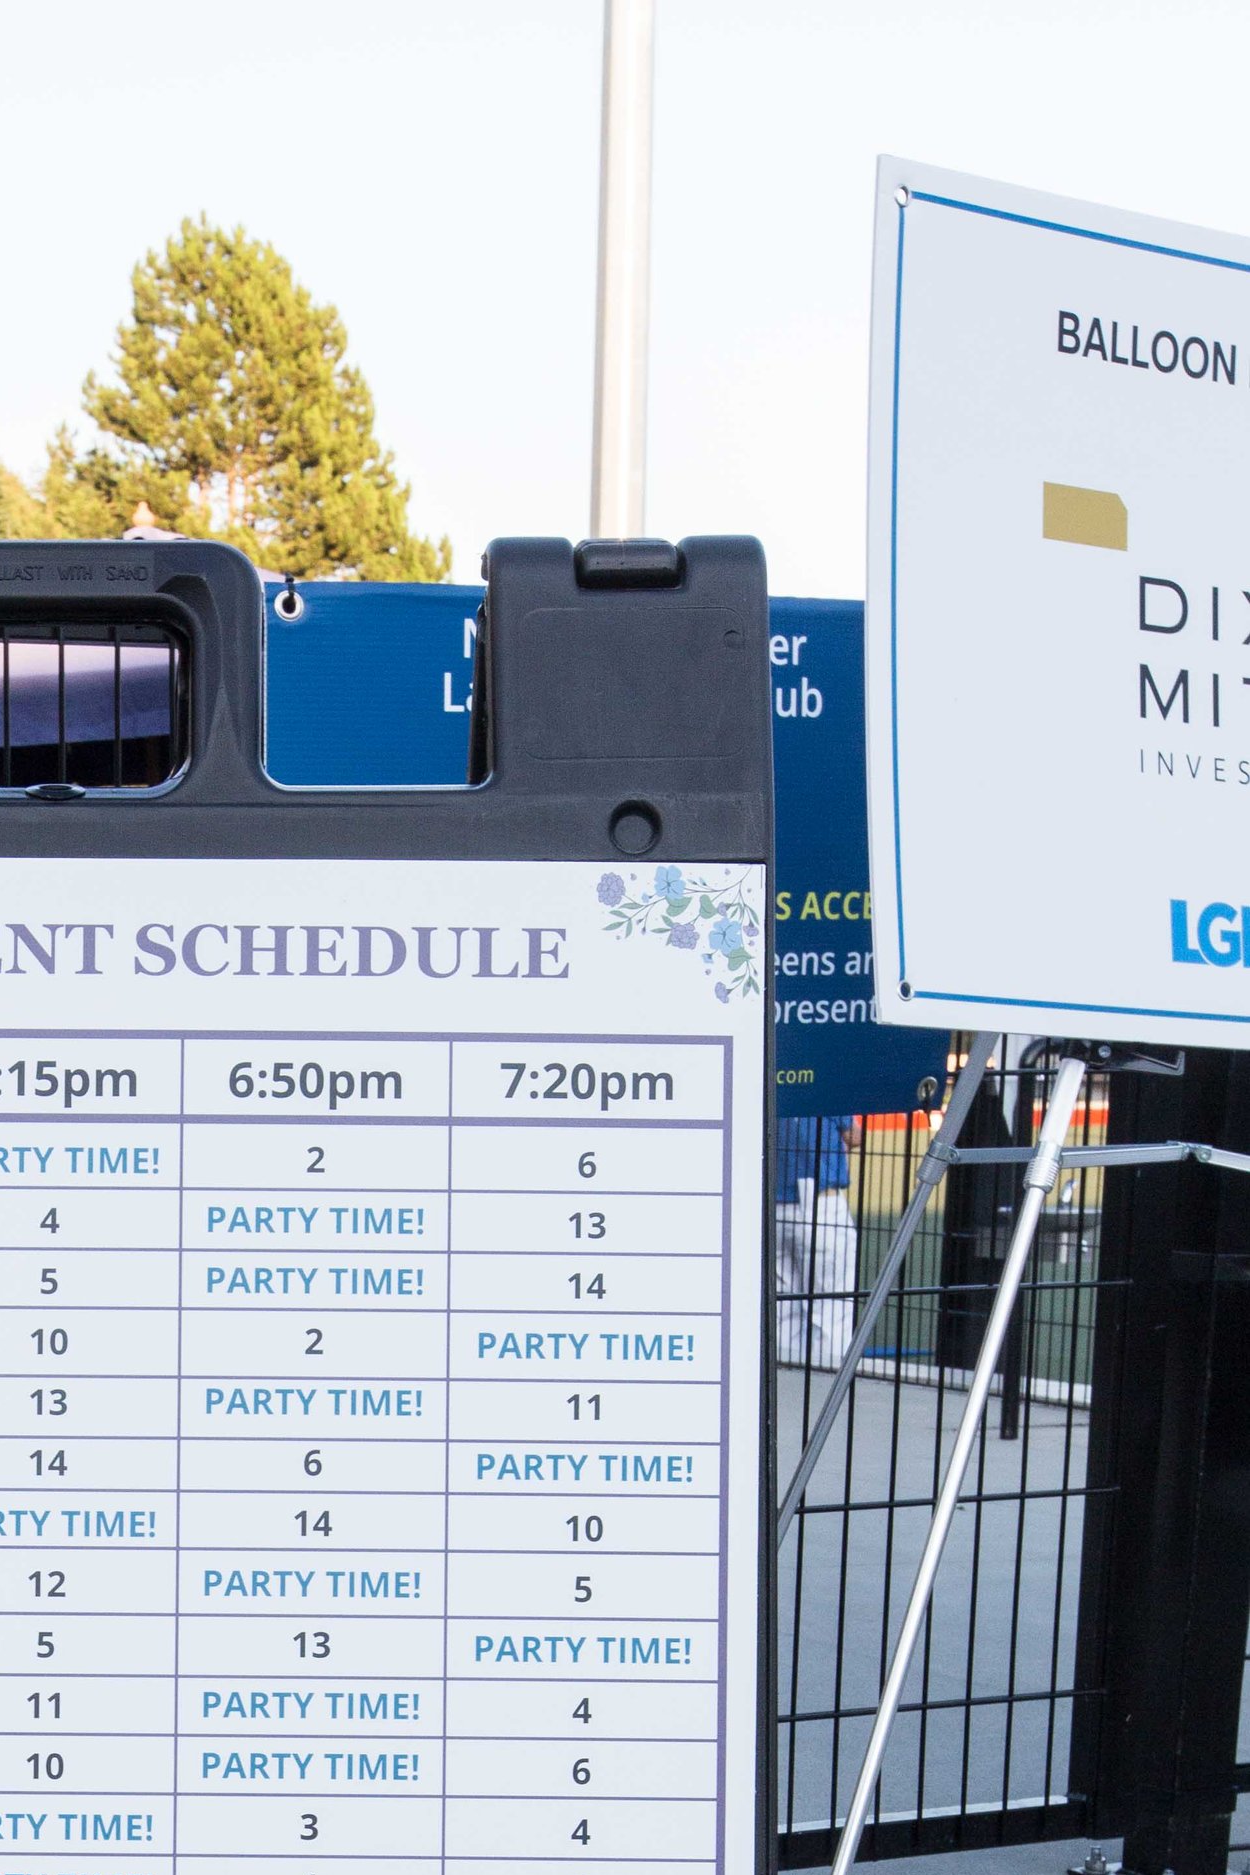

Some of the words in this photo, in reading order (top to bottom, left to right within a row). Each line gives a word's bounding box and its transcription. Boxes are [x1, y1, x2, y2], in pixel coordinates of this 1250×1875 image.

[1057, 309, 1237, 386] BALLOON
[56, 566, 94, 582] WITH
[105, 566, 149, 582] SAND
[1139, 575, 1250, 646] DI
[1139, 663, 1250, 728] MI
[134, 923, 570, 979] SCHEDULE
[228, 1061, 402, 1111] 6:50pm
[500, 1062, 674, 1112] 7:20pm
[64, 1147, 159, 1174] TIME!
[306, 1146, 326, 1174] 2
[578, 1151, 597, 1179] 6
[30, 1388, 68, 1416] 13
[205, 1388, 317, 1416] PARTY
[327, 1389, 423, 1417] TIME!
[566, 1393, 601, 1421] 11
[28, 1570, 66, 1598] 12
[204, 1569, 316, 1598] PARTY
[325, 1571, 421, 1599] TIME!
[574, 1575, 593, 1603] 5
[57, 1813, 153, 1841] TIME!
[300, 1813, 319, 1841] 3
[570, 1818, 591, 1846] 4
